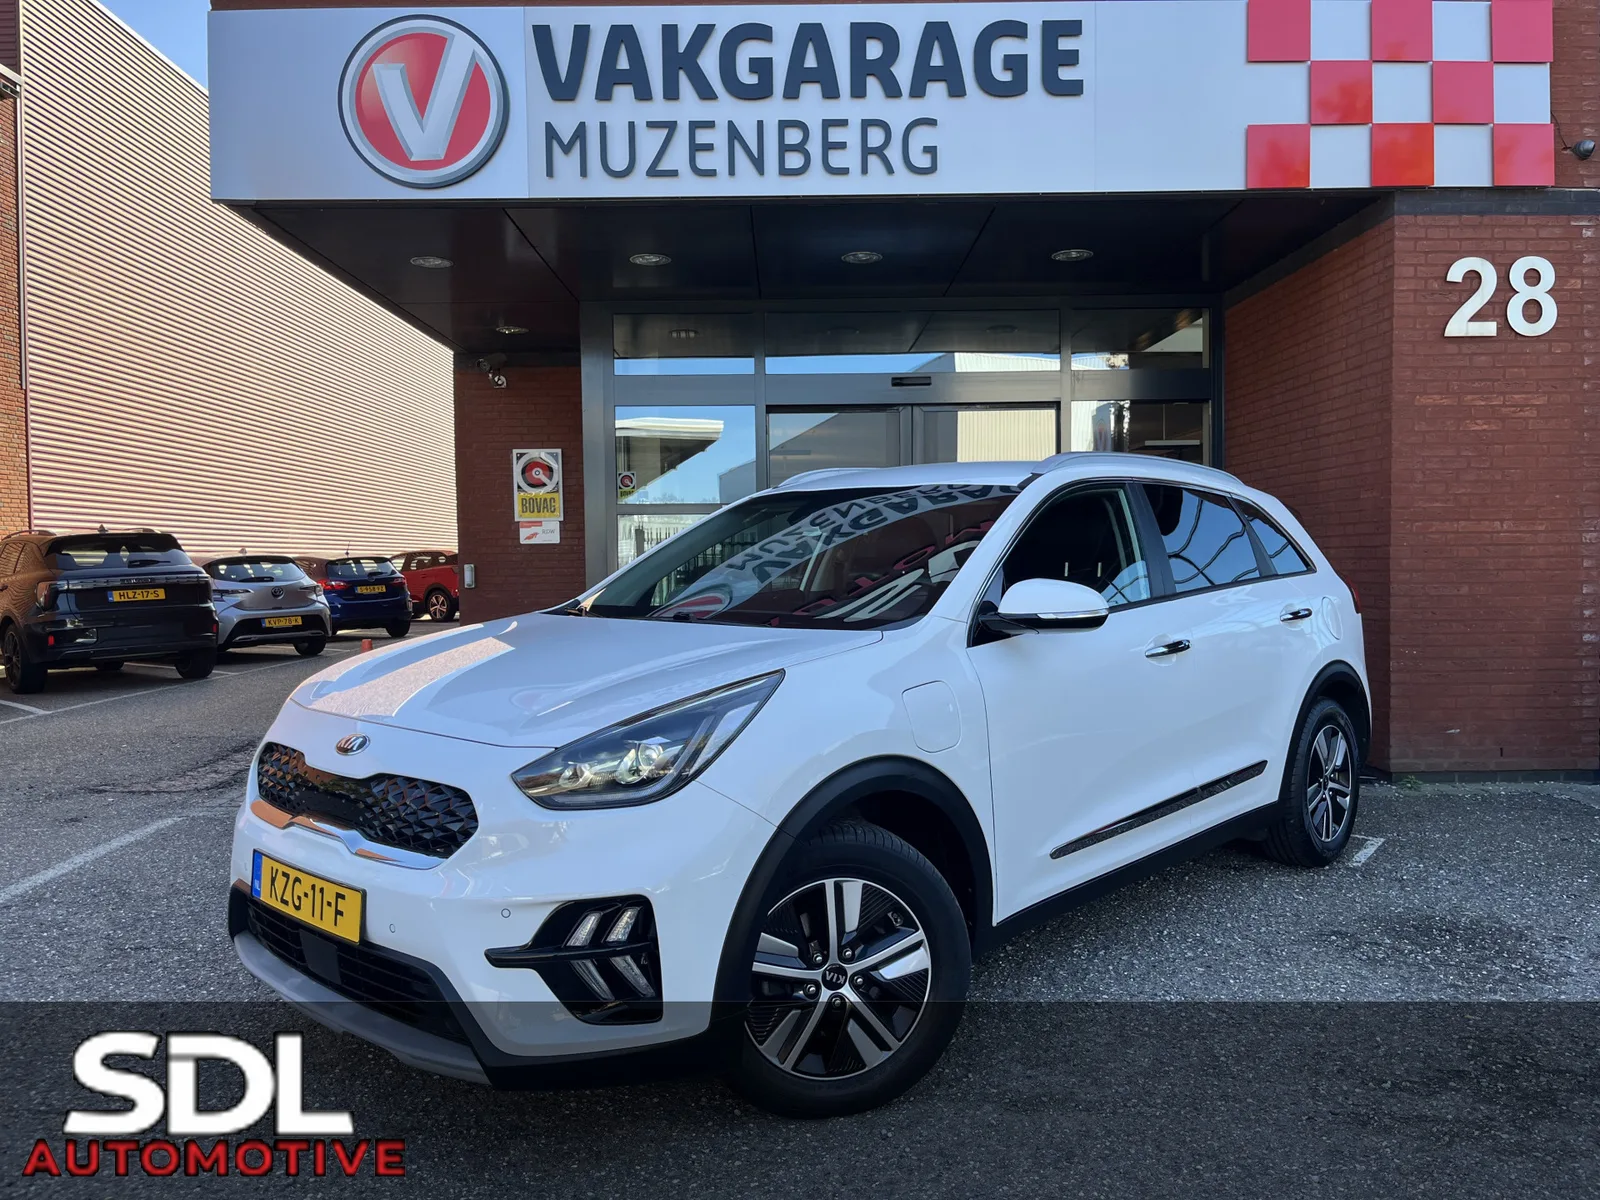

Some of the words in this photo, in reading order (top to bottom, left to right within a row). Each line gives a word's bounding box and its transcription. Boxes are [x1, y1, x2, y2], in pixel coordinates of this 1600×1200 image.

[531, 19, 1084, 101] VAKGARAGE
[544, 117, 939, 179] MUZENBERG
[1444, 255, 1558, 337] 28
[521, 497, 556, 514] BOVAG
[118, 590, 160, 600] HLZ-17-S
[337, 736, 363, 751] KIA
[270, 866, 346, 926] KZG-11-F
[825, 970, 846, 985] KIA
